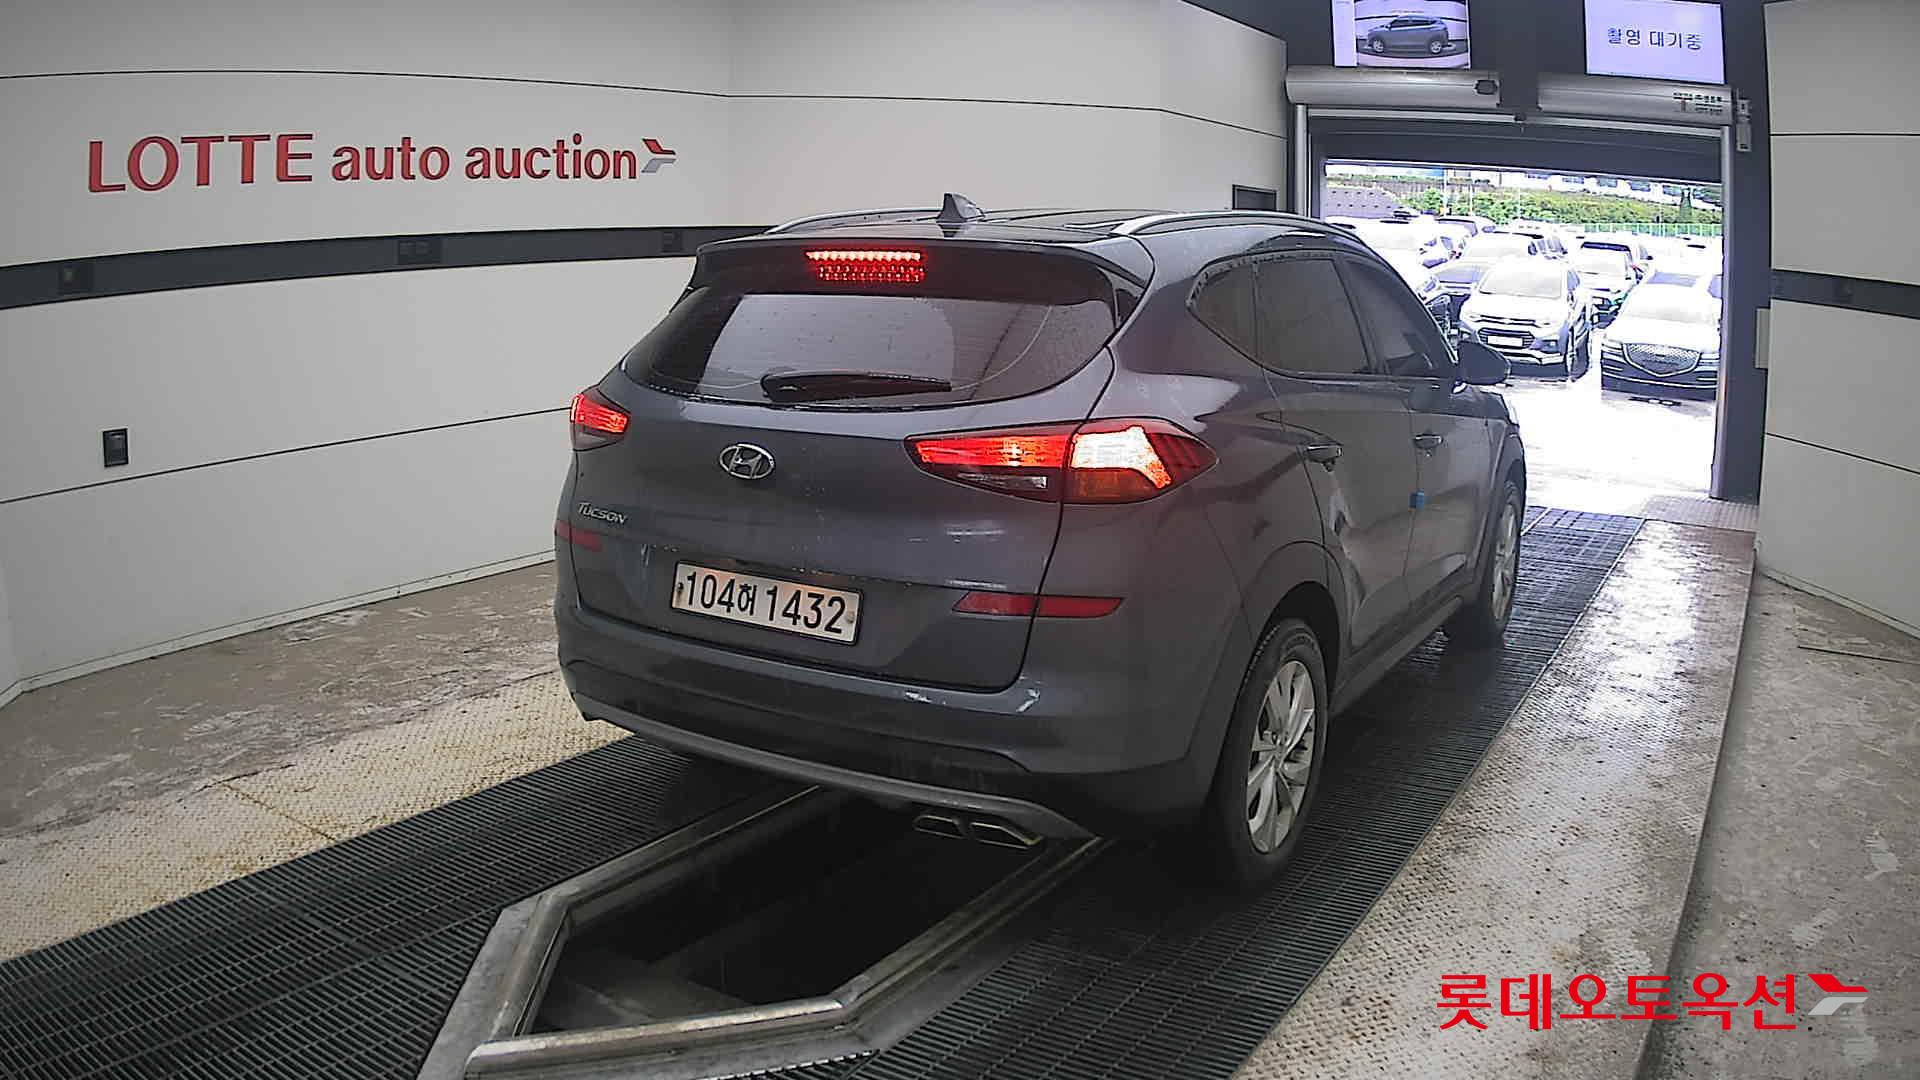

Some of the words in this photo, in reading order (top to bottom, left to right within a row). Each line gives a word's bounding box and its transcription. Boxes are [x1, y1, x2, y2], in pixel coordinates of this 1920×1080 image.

[88, 133, 313, 193] LOTTE
[331, 136, 450, 181] auto
[464, 133, 638, 180] auction
[687, 571, 757, 616] 104허
[766, 585, 846, 634] 1432
